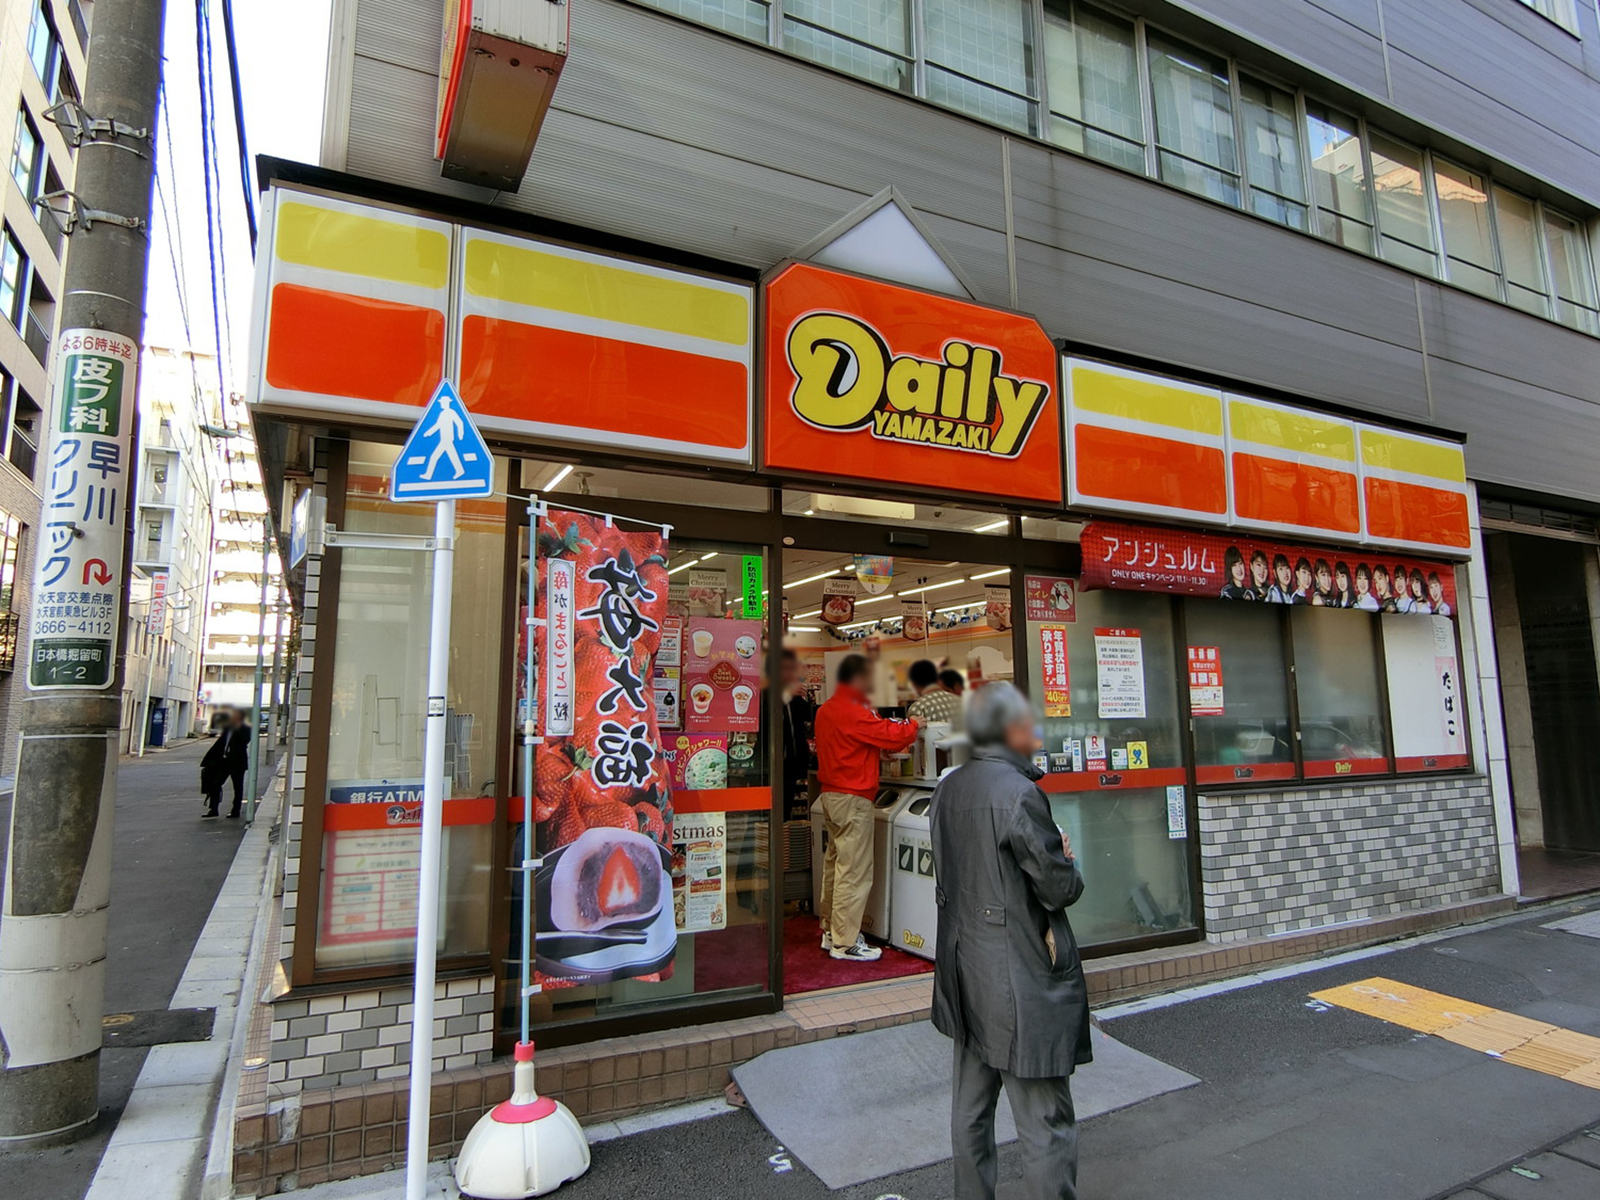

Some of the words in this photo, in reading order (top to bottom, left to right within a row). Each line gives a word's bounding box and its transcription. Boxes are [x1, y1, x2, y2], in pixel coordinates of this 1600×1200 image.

[62, 336, 132, 359] よる6時半迄
[69, 357, 113, 433] 皮フ科
[787, 311, 1049, 456] Daily
[873, 410, 991, 450] YAMAZAKI
[82, 440, 121, 526] 早川
[42, 439, 82, 587] クリニック
[1102, 536, 1216, 574] アンジュルム
[1111, 568, 1131, 580] ONLY
[38, 592, 113, 605] 水天宮交差点際
[1028, 590, 1049, 599] トイレ
[35, 620, 111, 635] 3666-4112
[36, 648, 102, 662] 日本橋堀留町
[1042, 630, 1053, 675] 承ります
[50, 666, 87, 680] 1-2
[1442, 672, 1455, 735] たばこ
[673, 825, 724, 840] stmas
[903, 930, 924, 948] Daily
